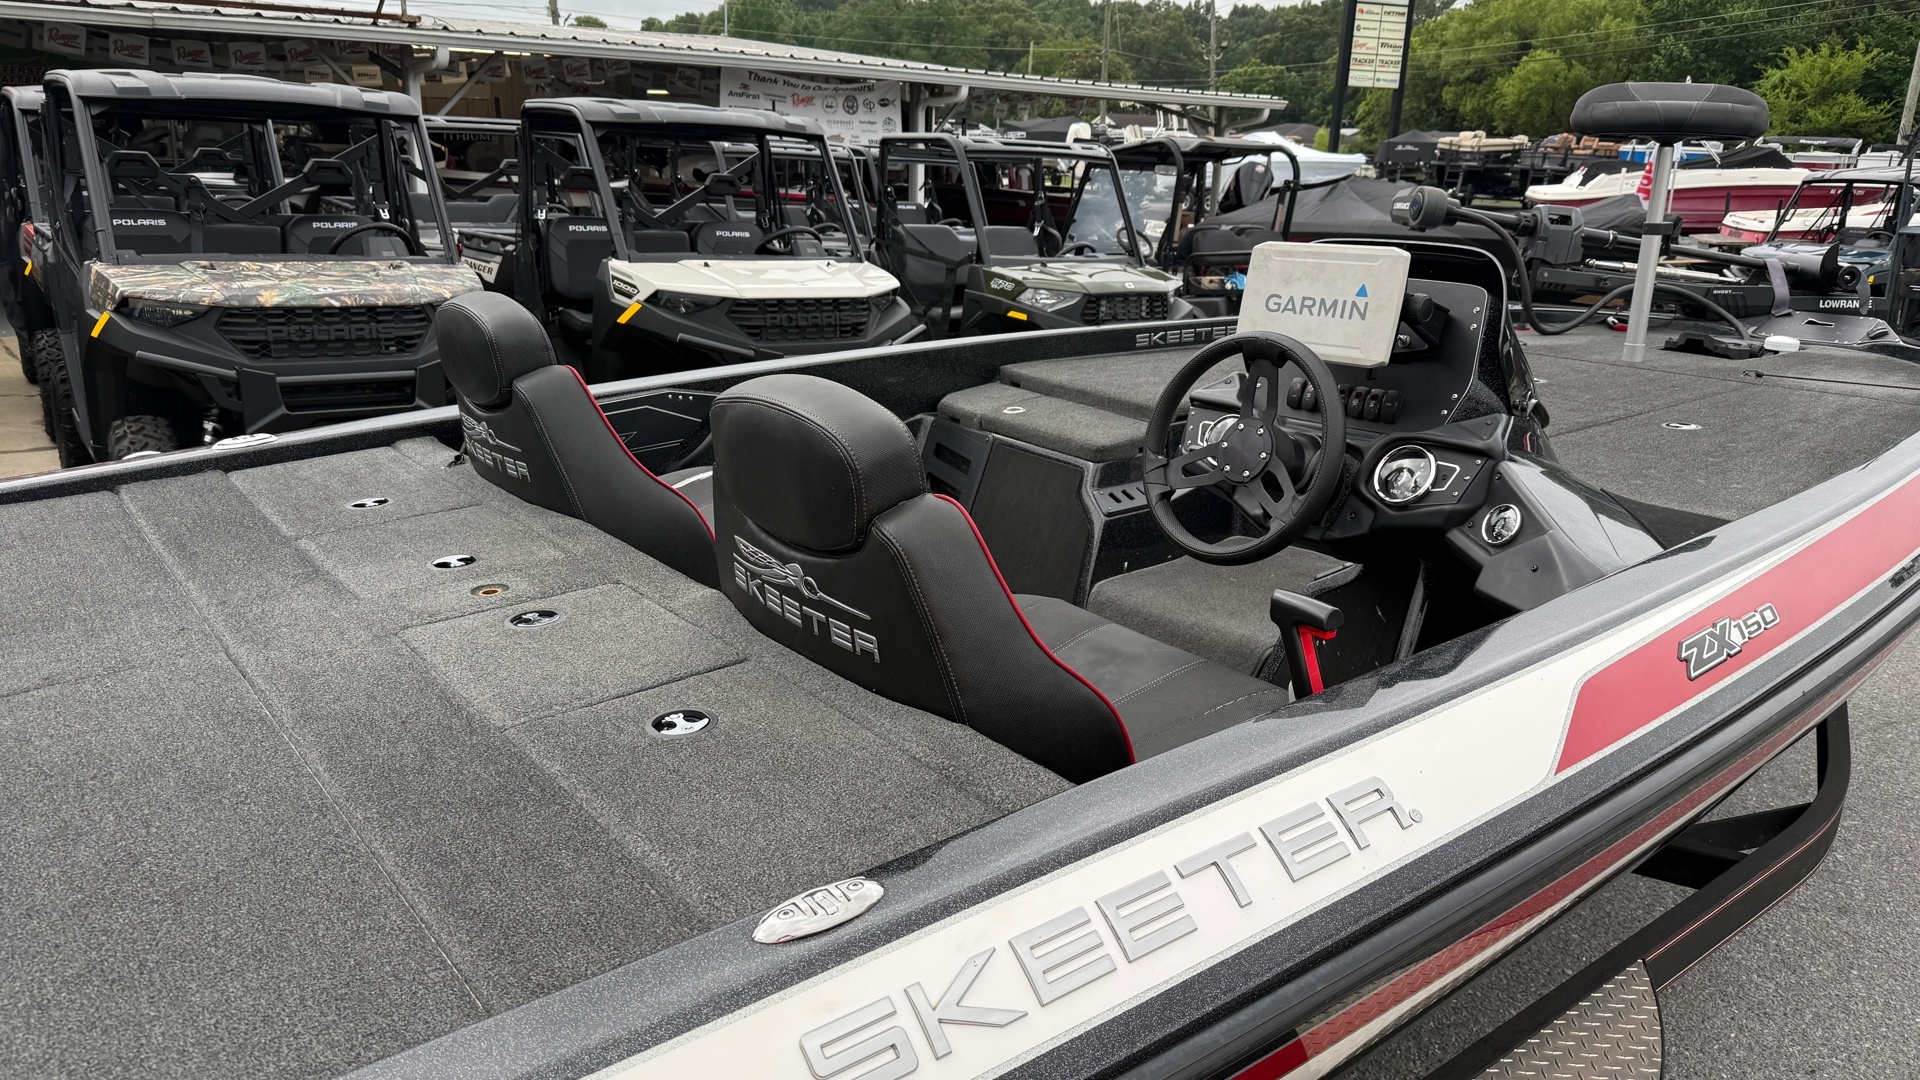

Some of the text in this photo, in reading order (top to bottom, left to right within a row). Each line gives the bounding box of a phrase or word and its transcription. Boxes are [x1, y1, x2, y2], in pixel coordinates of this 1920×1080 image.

[47, 27, 81, 44] Ranger
[112, 38, 144, 57] Ranger
[175, 46, 206, 61] Ranger
[232, 50, 261, 64] Ranger
[747, 70, 780, 85] Thank
[782, 80, 800, 91] You
[832, 84, 875, 93] Sponsors!
[728, 90, 760, 100] AmFirst
[791, 93, 815, 108] Ranger
[716, 230, 751, 238] POLARIS
[612, 279, 640, 294] 1000
[1263, 292, 1370, 321] GARMIN
[1818, 299, 1873, 309] LOWRANE
[765, 313, 850, 327] POLARIS
[266, 324, 399, 342] POLARIS
[733, 561, 881, 665] SKEETER
[797, 775, 1413, 1080] SKEETER
